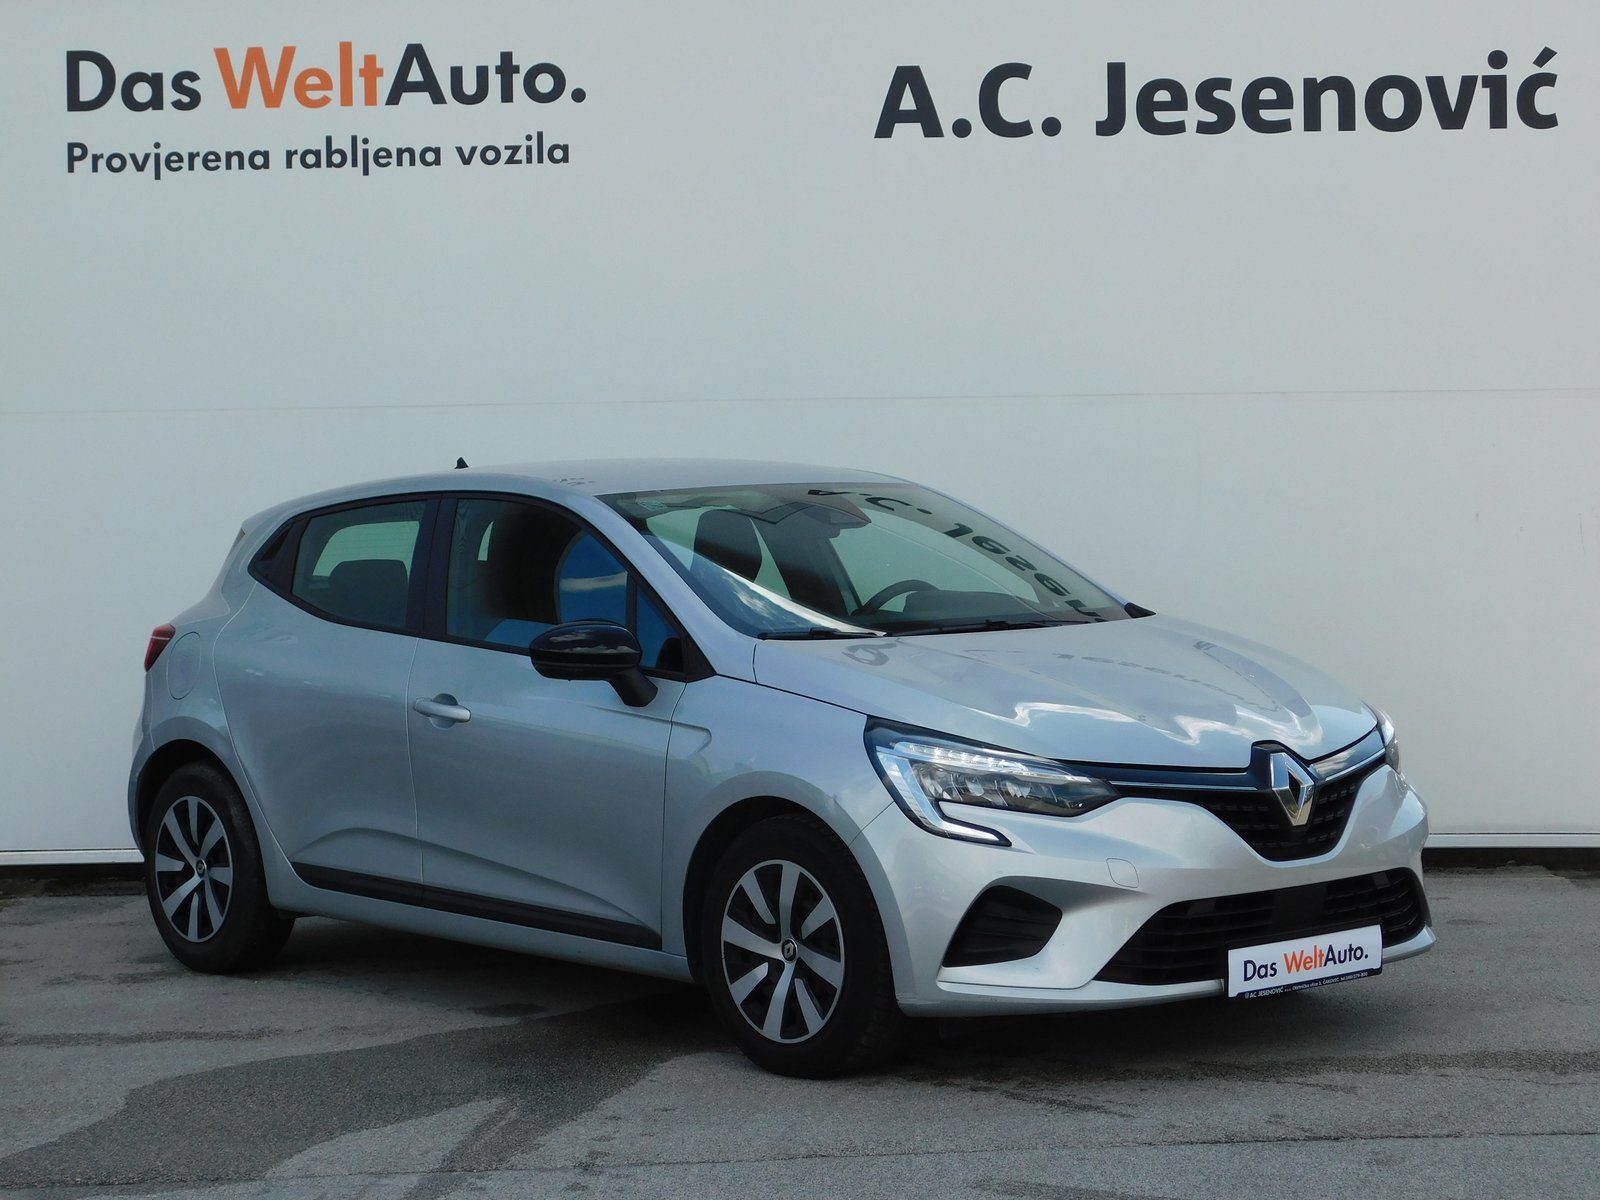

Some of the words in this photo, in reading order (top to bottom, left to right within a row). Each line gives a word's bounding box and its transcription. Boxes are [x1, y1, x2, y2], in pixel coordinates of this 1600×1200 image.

[67, 51, 202, 113] Das
[214, 41, 587, 110] WeltAuto.
[874, 62, 1062, 139] A.C.
[1096, 46, 1559, 137] Jesenović
[67, 142, 271, 181] Provjerena
[286, 132, 442, 177] rabljena
[454, 131, 570, 167] vozila
[1243, 959, 1278, 982] Das
[1284, 943, 1369, 974] WeltAuto.
